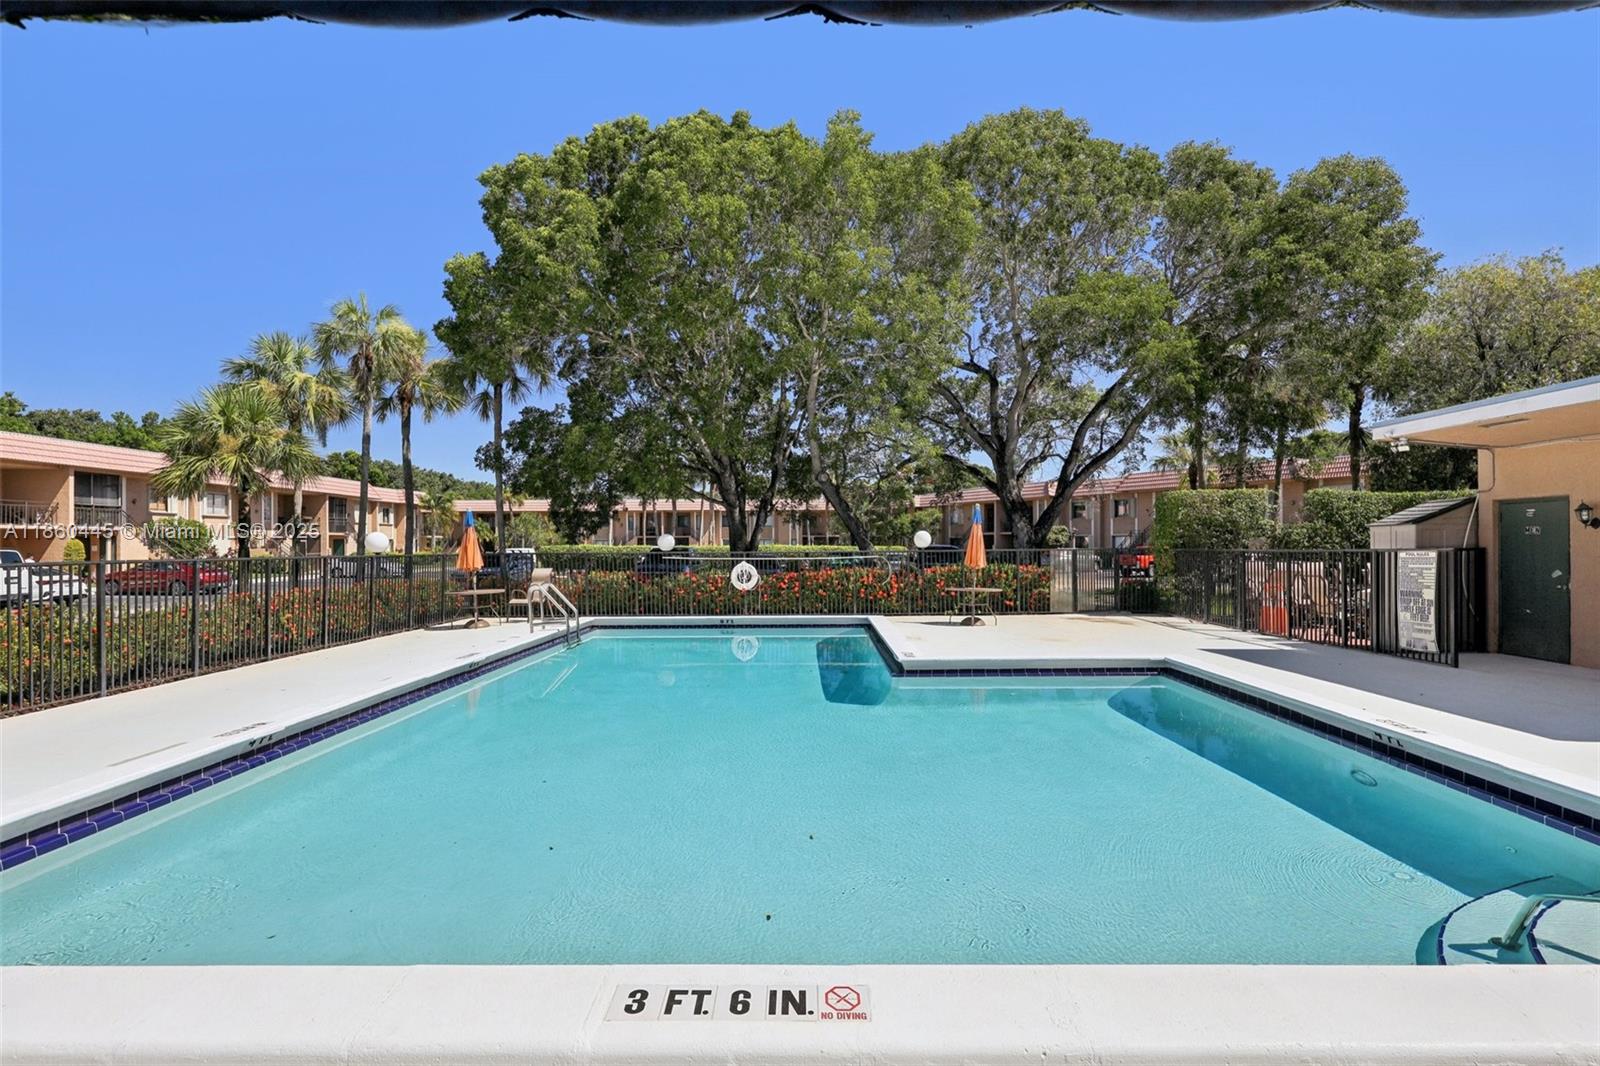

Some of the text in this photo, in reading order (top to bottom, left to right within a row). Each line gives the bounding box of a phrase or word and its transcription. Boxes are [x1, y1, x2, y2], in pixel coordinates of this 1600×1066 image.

[623, 989, 815, 1016] 3 FT. 6 IN.
[820, 1012, 868, 1020] NO DIVING
